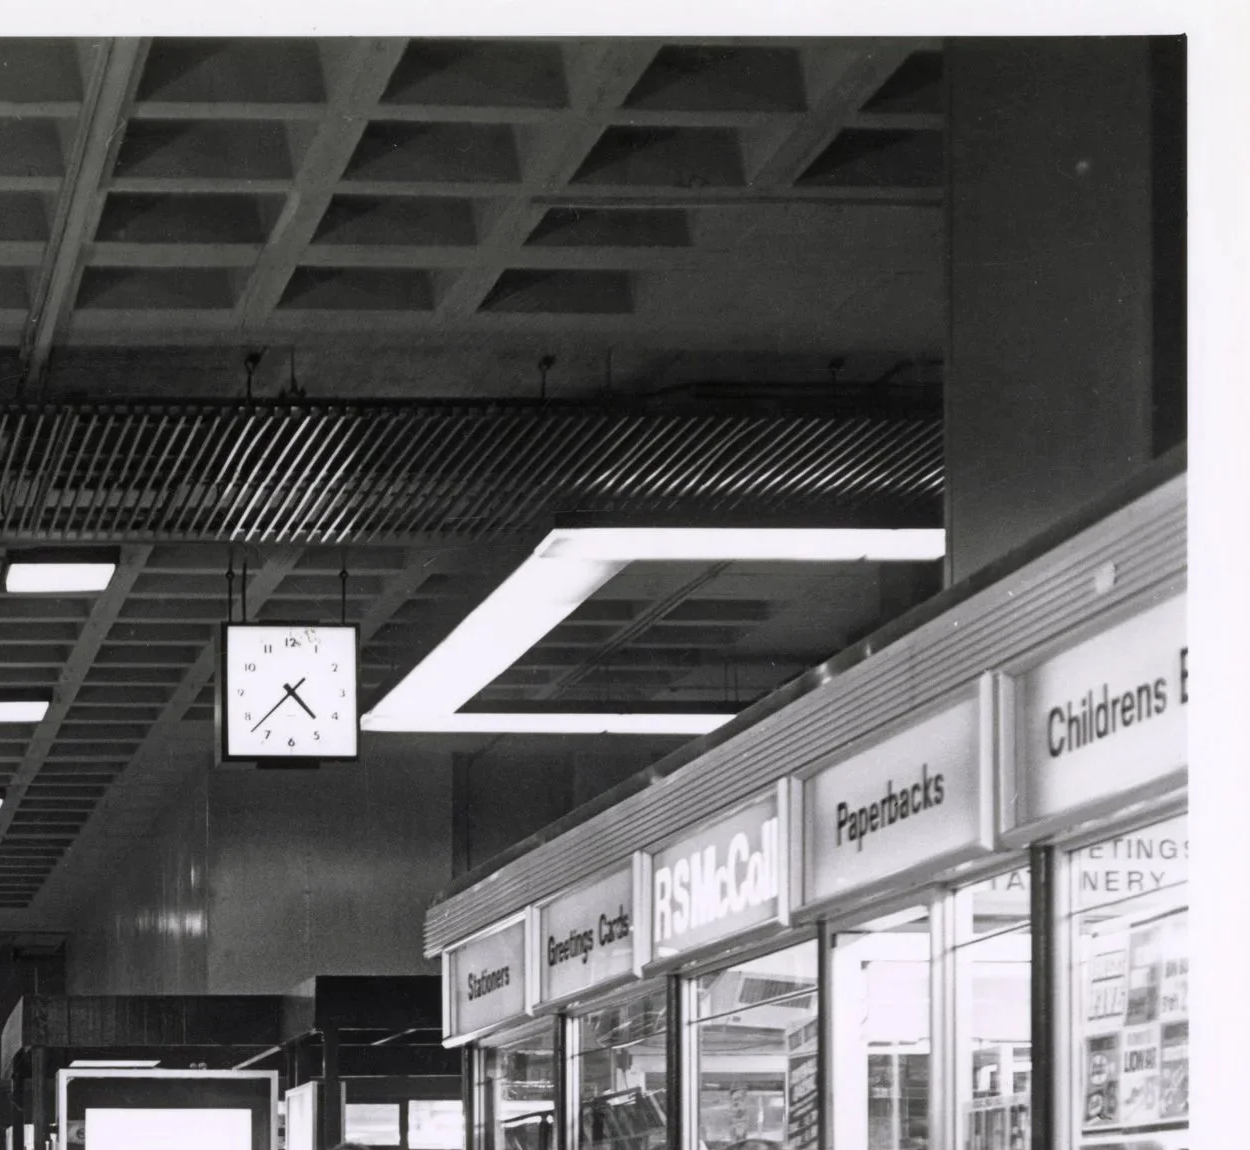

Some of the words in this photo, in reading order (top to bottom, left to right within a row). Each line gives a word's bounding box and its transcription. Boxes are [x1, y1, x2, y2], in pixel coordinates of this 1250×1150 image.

[285, 637, 296, 648] 12
[264, 644, 272, 654] 11
[244, 662, 256, 672] 10
[331, 662, 338, 672] 2
[237, 688, 244, 697] 9
[340, 688, 346, 698] 3
[244, 712, 251, 721] 8
[331, 711, 338, 720] 4
[1047, 683, 1167, 757] Childrens
[264, 730, 271, 740] 7
[313, 731, 320, 741] 5
[287, 737, 295, 747] 6
[836, 763, 944, 850] Paperbacks
[547, 929, 594, 967] Greetings
[598, 903, 630, 946] Cards
[466, 966, 510, 1001] Stationers
